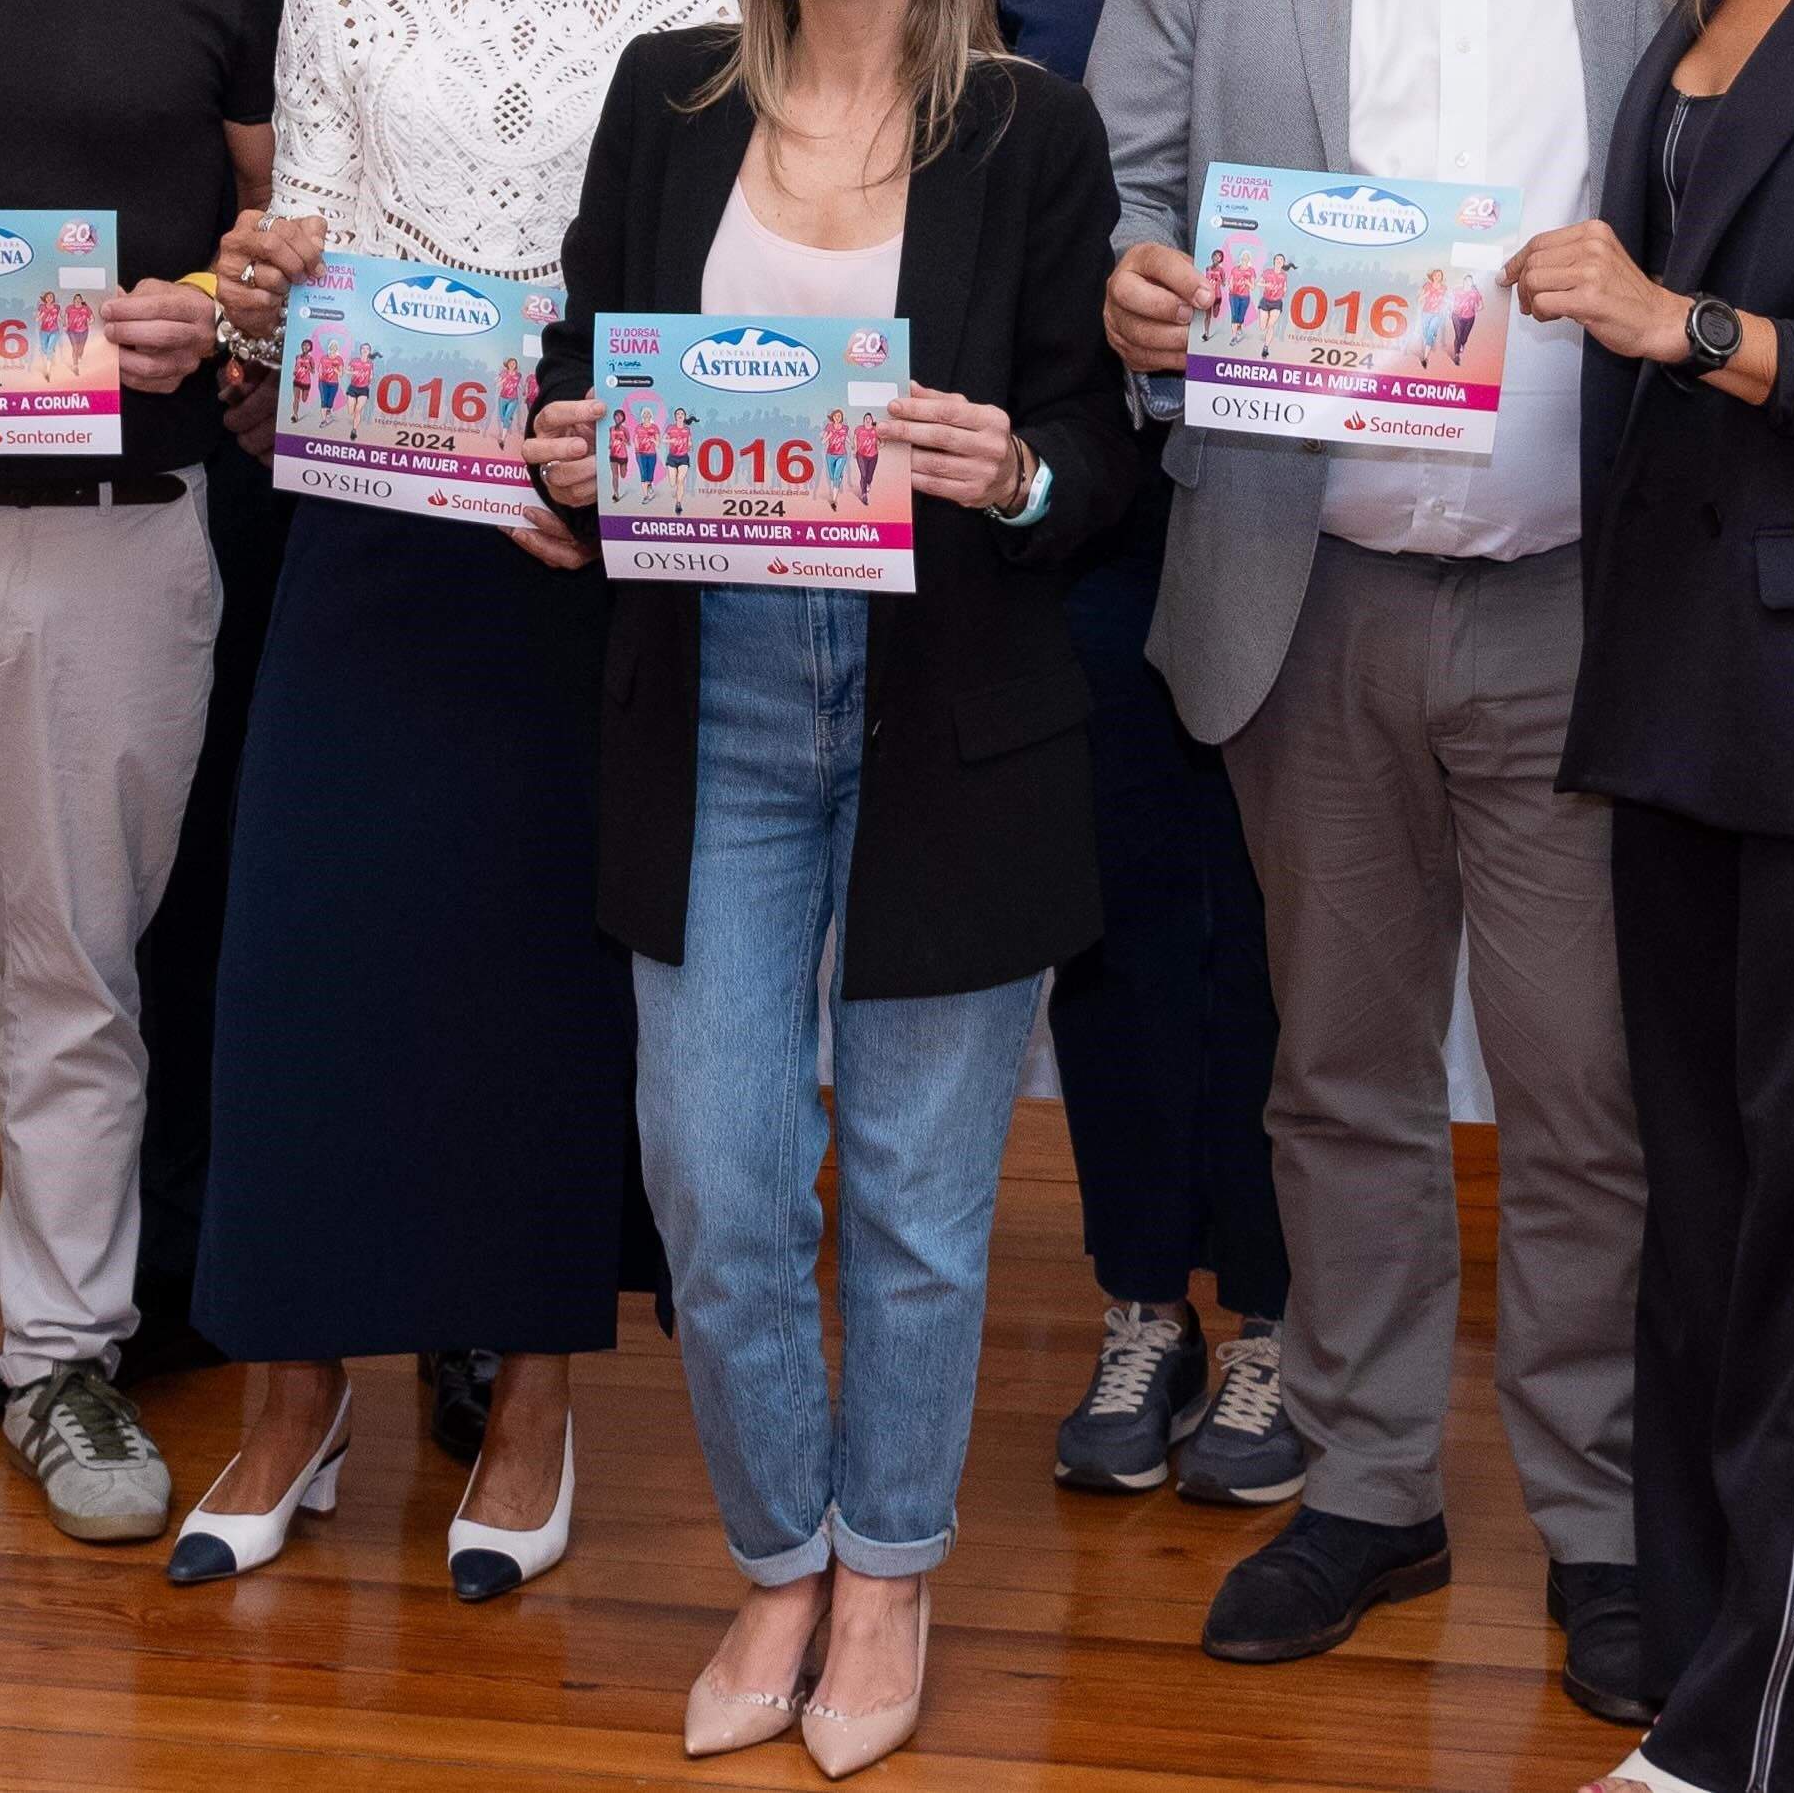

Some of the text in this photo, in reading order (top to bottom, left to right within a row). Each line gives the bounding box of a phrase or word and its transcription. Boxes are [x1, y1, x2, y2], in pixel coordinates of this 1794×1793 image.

[1299, 202, 1416, 234] ASTURIANA
[383, 293, 490, 325] ASTURIANA
[1291, 286, 1410, 339] 016
[609, 339, 659, 354] SUMA
[692, 351, 809, 376] ASTURIANA
[1310, 348, 1374, 369] 2024
[1216, 362, 1466, 402] CARRERA DE LA MUJER A CORUÑA
[21, 398, 31, 409] A
[35, 394, 89, 409] CORUÑA
[377, 374, 487, 423] 016
[1212, 396, 1304, 424] OYSHO
[7, 430, 93, 443] Santander
[1370, 417, 1463, 438] Santander
[395, 431, 455, 451] 2024
[306, 443, 365, 462] CARRERA
[370, 450, 388, 465] DE
[392, 453, 408, 467] LA
[412, 458, 458, 473] MUJER
[470, 463, 480, 475] A
[697, 437, 814, 484] 016
[302, 469, 392, 498] OYSHO
[722, 499, 785, 517] 2024
[632, 521, 879, 542] CARRERA DE LA MUJER A CORUÑA
[634, 552, 728, 572] OYSHO
[792, 561, 883, 579] Santander
